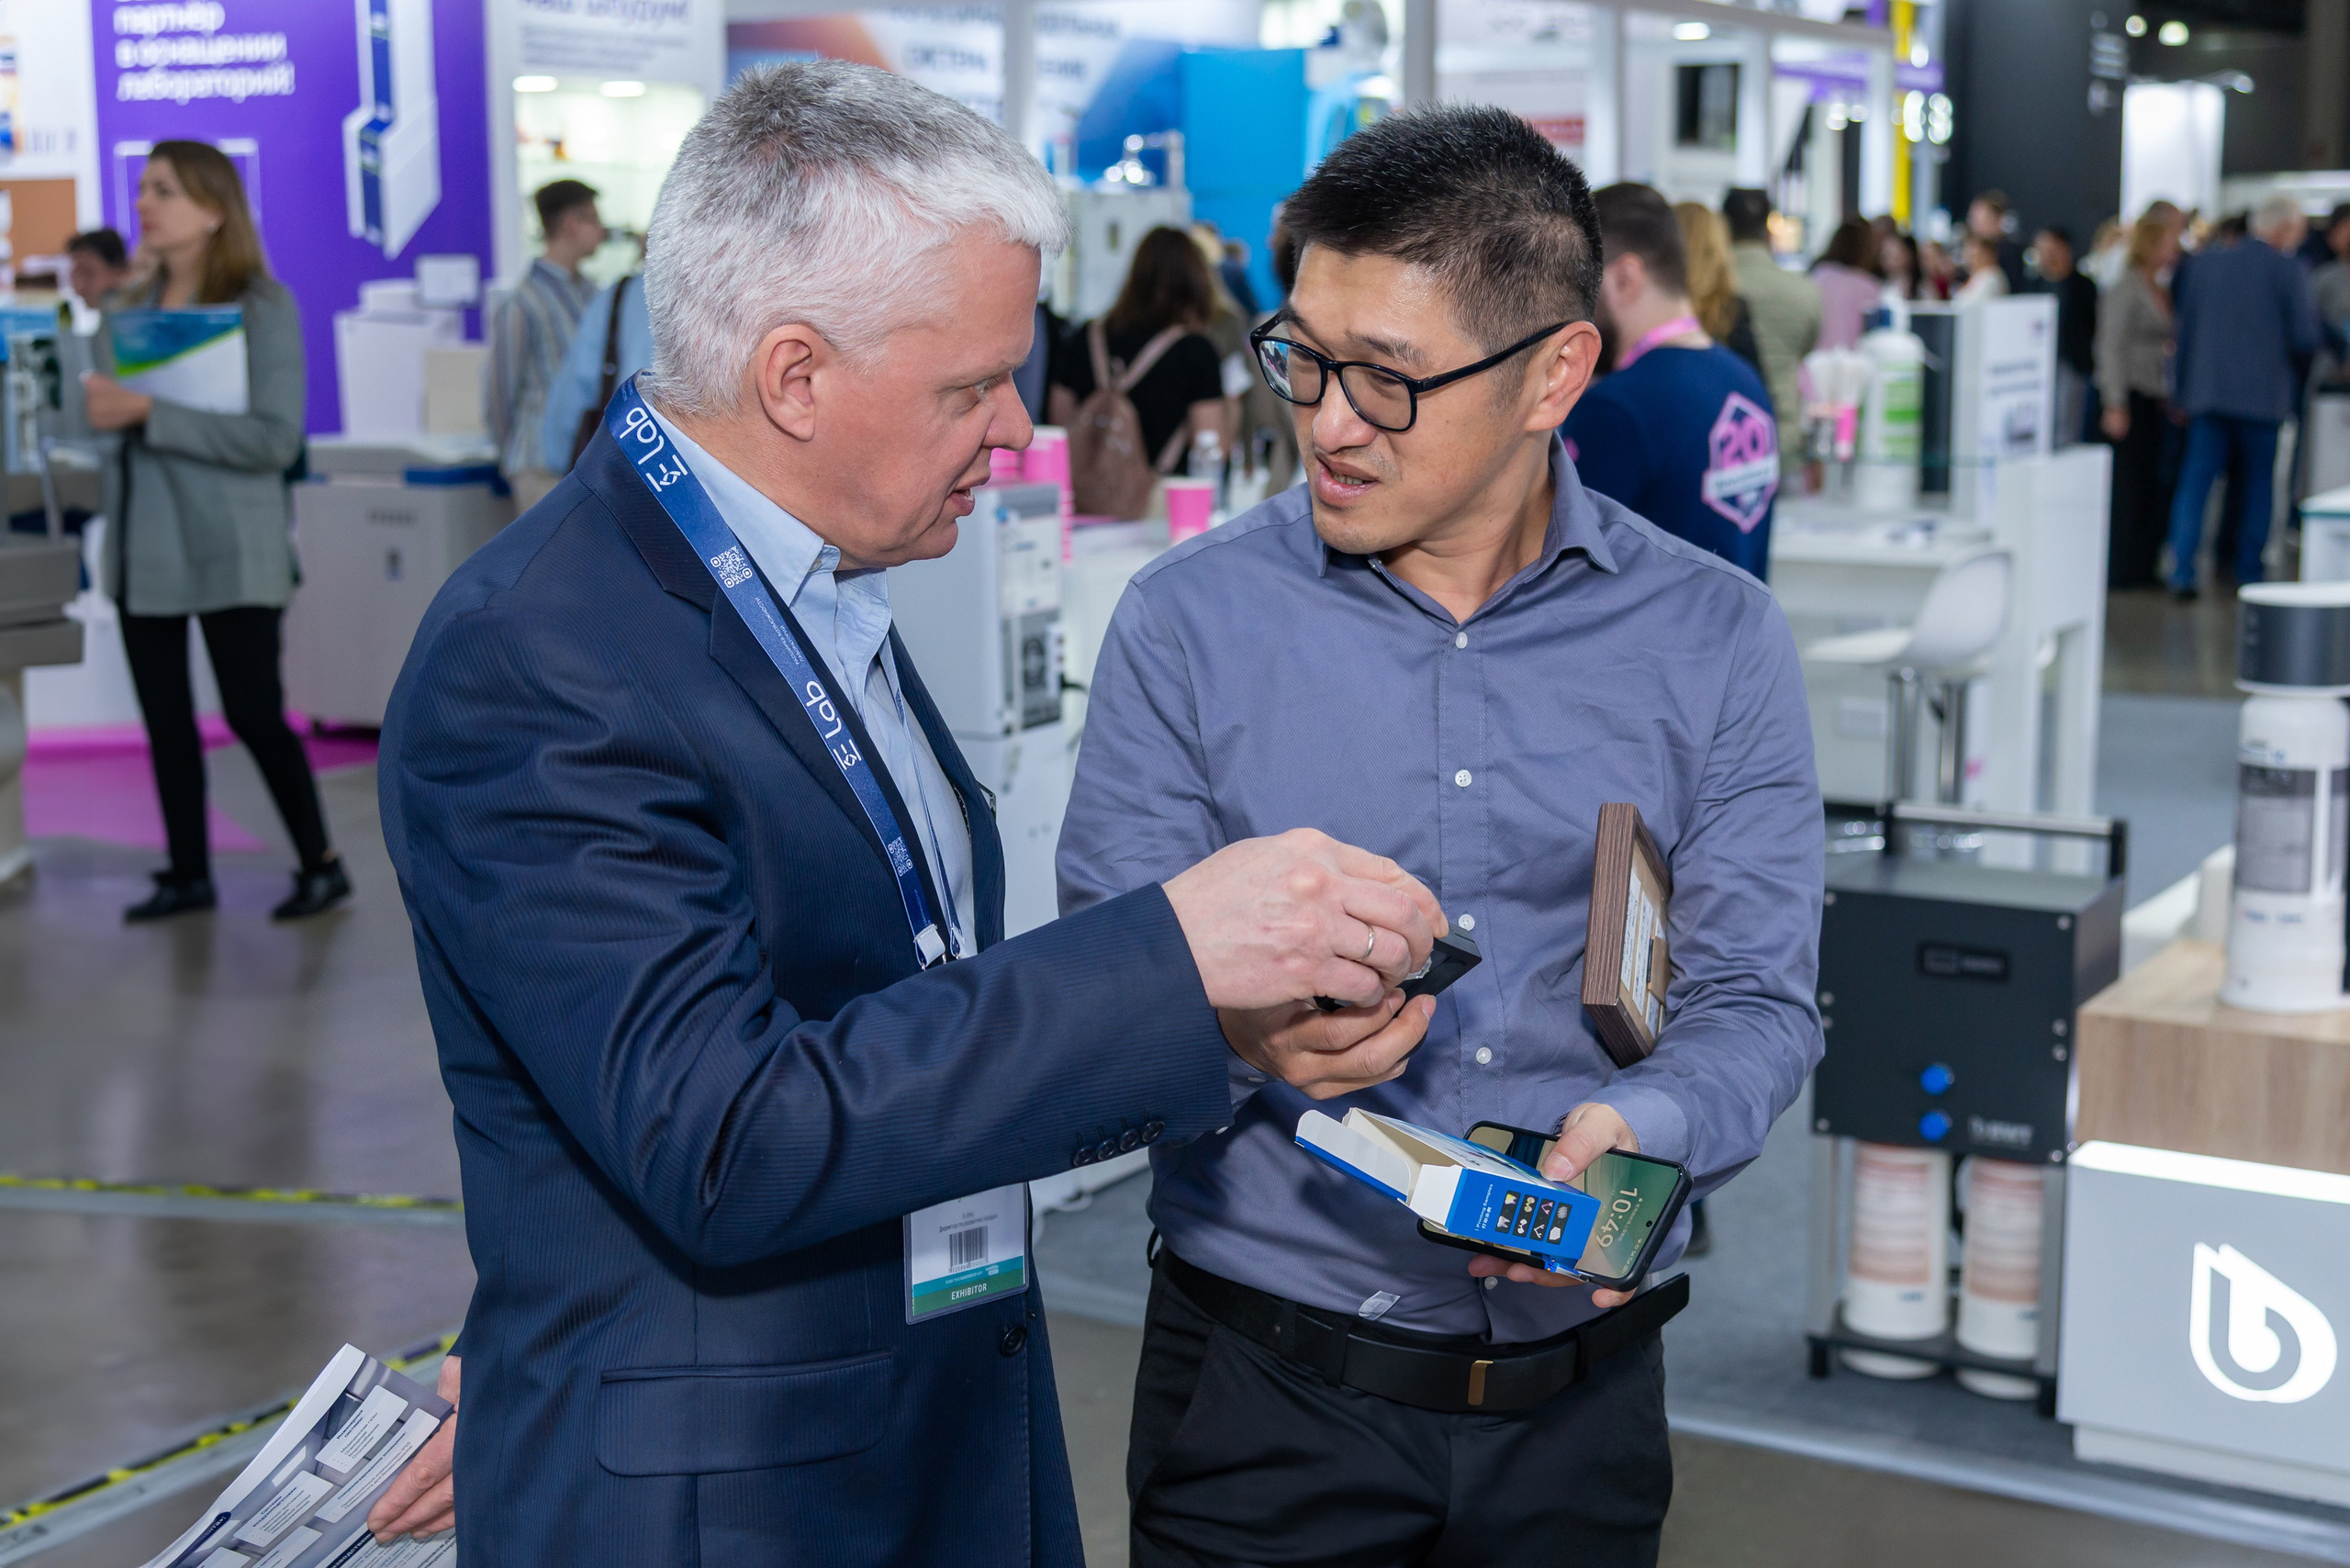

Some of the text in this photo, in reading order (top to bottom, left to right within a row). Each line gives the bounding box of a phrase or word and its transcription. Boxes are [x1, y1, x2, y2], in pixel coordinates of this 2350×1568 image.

[1475, 1183, 1493, 1227] Printing Samples
[1596, 1187, 1638, 1248] 10:49
[951, 1283, 987, 1300] EXHIBITOR
